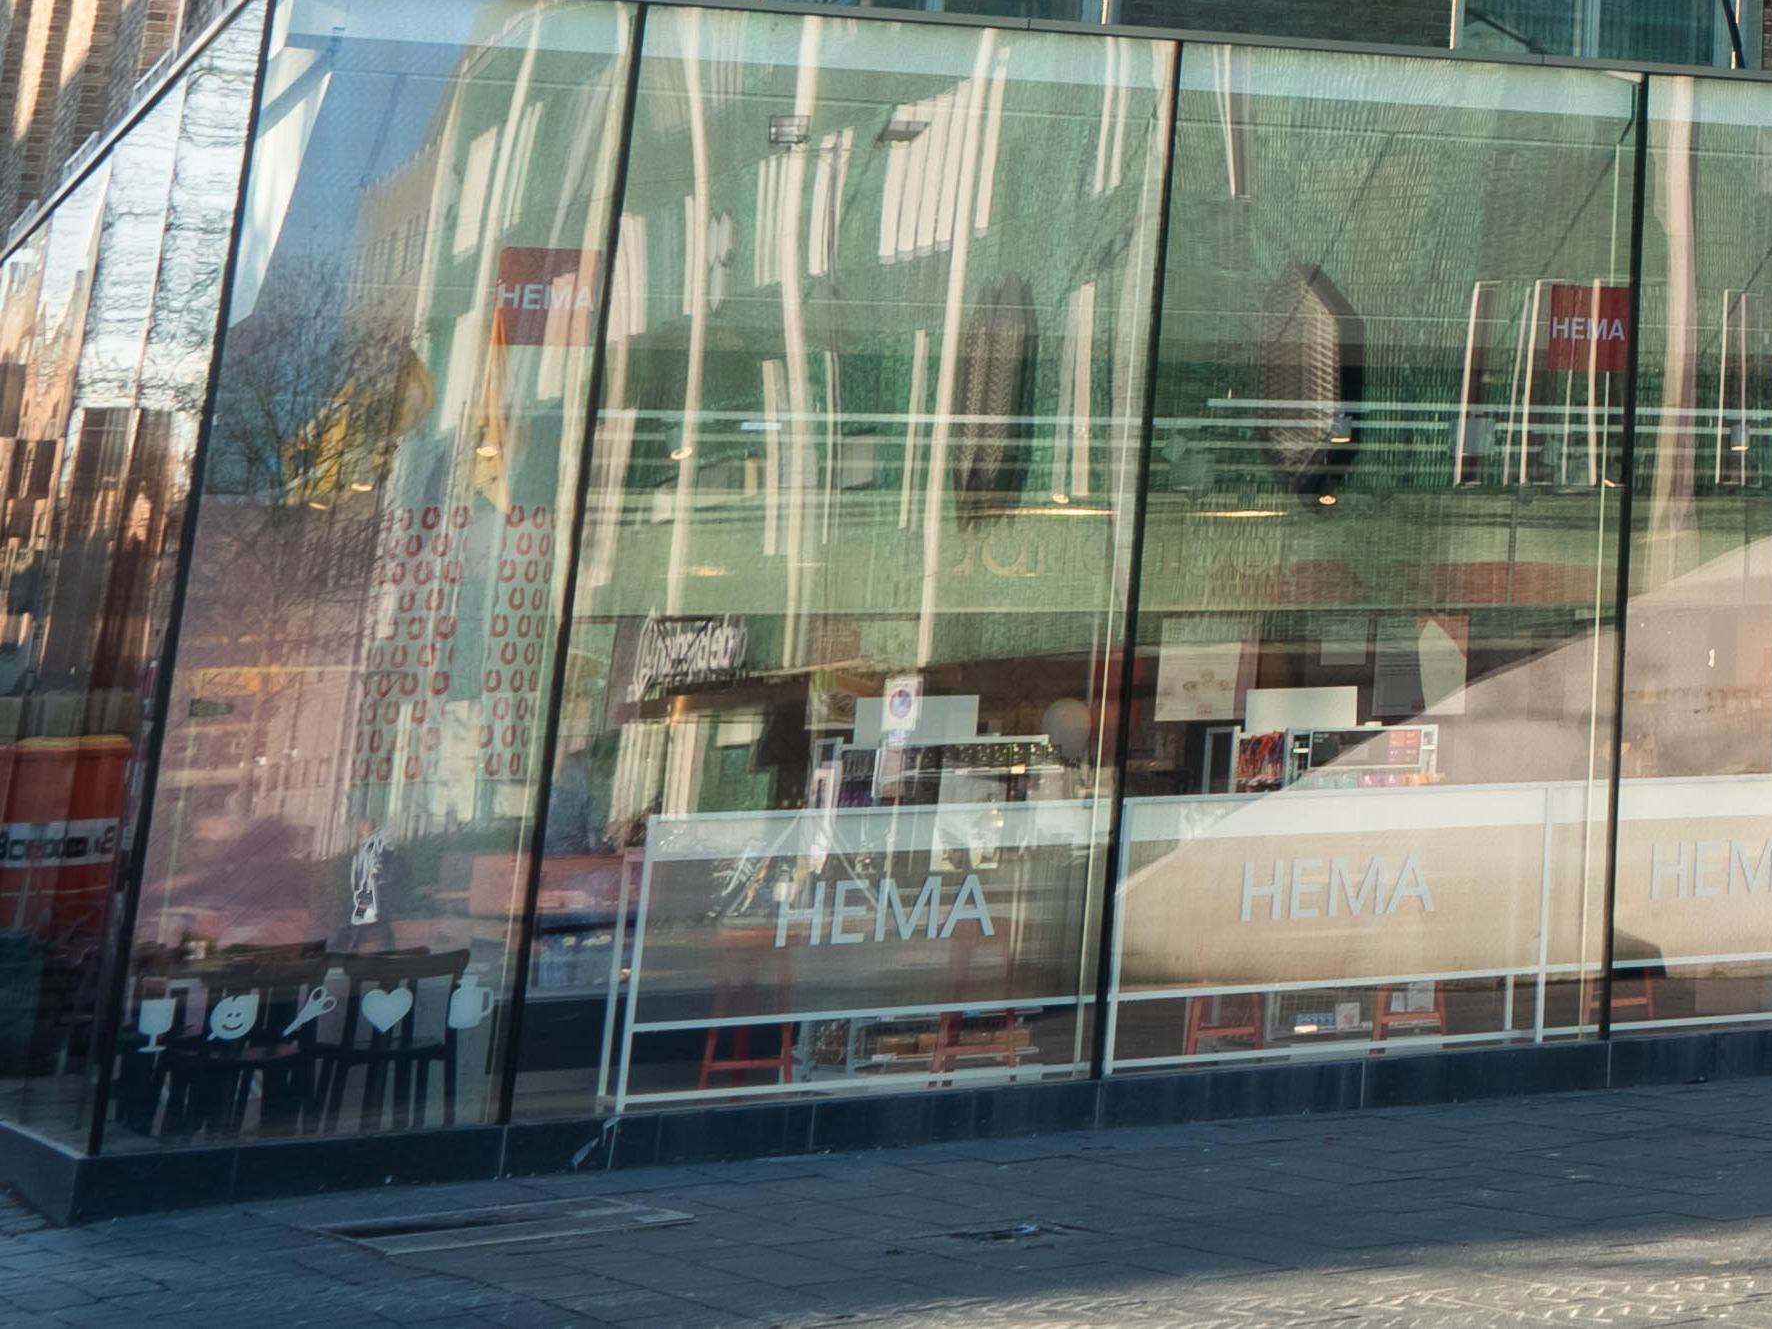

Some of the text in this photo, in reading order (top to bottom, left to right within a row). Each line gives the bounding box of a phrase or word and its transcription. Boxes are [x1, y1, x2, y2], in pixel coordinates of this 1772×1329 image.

[495, 283, 594, 310] HEMA
[1552, 317, 1625, 340] HEMA
[774, 874, 995, 948] HEMA
[1239, 853, 1435, 923] HEMA
